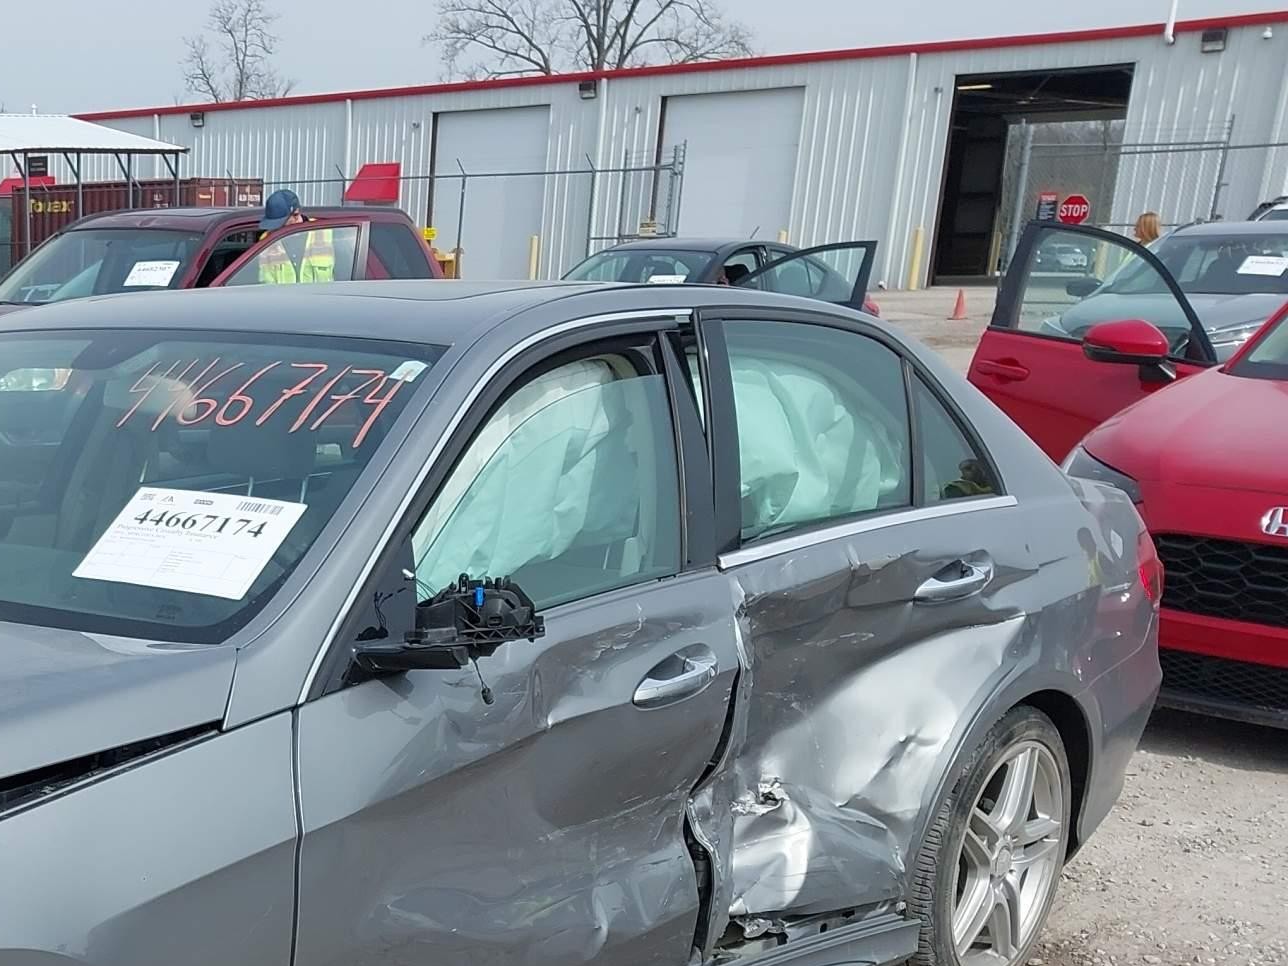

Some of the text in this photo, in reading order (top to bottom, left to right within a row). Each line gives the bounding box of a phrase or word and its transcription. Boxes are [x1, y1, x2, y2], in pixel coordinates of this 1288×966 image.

[1060, 204, 1088, 217] STOP
[116, 357, 412, 448] 44667174
[133, 508, 268, 538] 44667174
